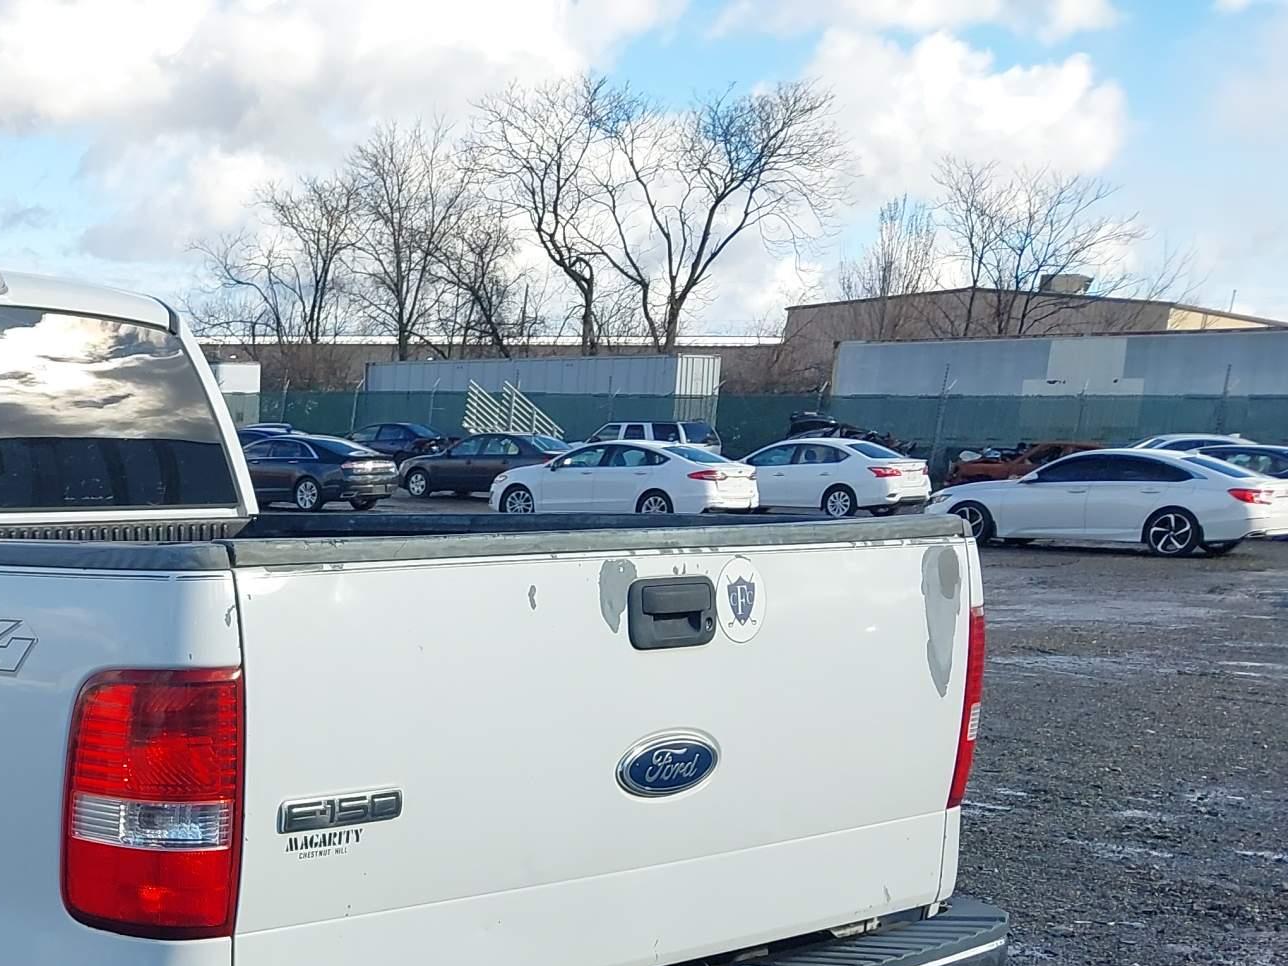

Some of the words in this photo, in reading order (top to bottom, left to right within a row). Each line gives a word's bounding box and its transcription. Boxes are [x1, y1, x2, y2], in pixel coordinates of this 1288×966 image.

[646, 747, 700, 783] Ford
[298, 848, 332, 860] CHESTNUT
[334, 847, 348, 855] HILL
